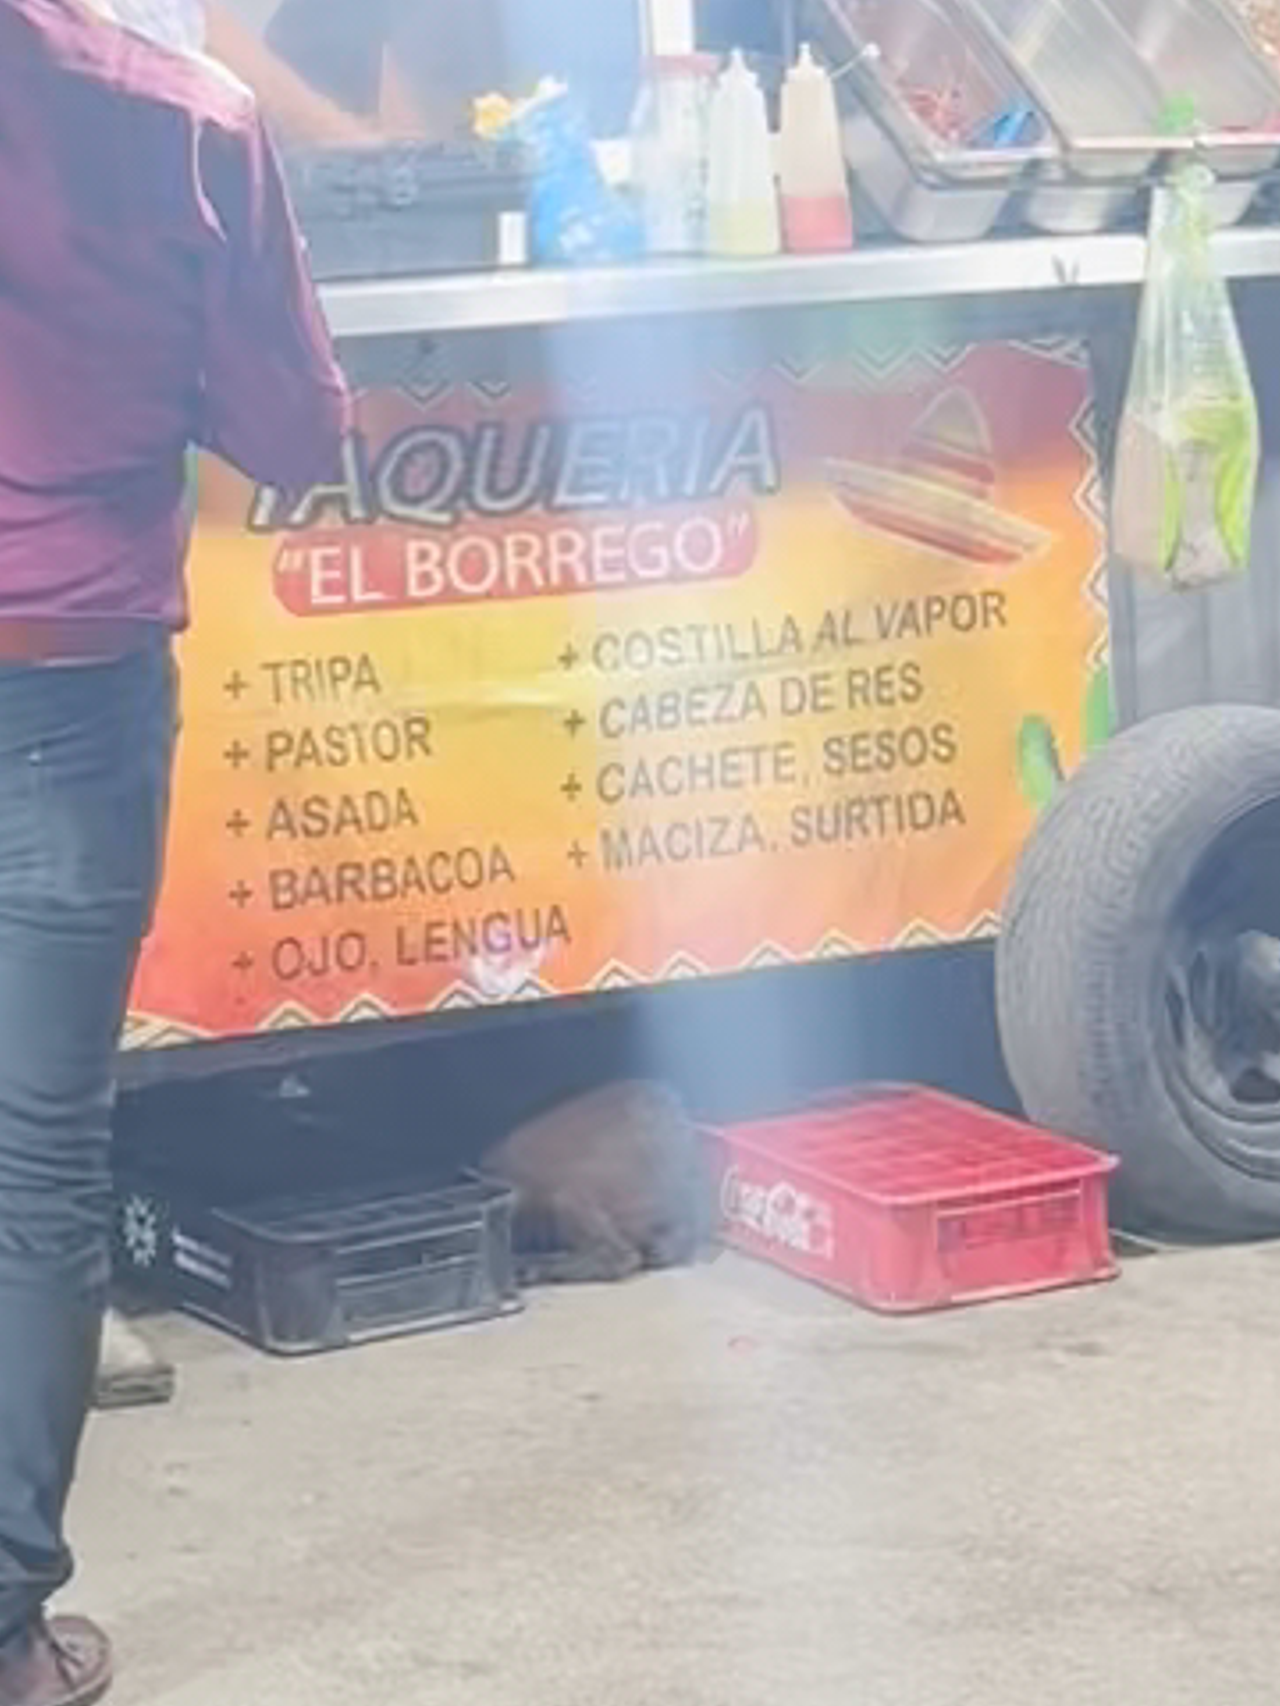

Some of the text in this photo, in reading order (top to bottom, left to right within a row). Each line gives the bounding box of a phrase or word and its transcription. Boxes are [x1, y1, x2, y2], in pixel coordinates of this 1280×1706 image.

[592, 614, 803, 672] COSTILLA
[810, 607, 870, 652] AL
[874, 590, 1008, 642] VAPOR
[261, 652, 382, 704] TRIPA
[599, 680, 767, 739] CABEZA
[780, 672, 836, 717] DE
[846, 660, 926, 710] RES
[265, 716, 433, 773] PASTOR
[823, 722, 959, 777] SESOS
[266, 787, 420, 840] ASADA
[790, 789, 967, 848] SURTIDA
[269, 844, 517, 911] BARBACOA
[396, 904, 572, 966] LENGUA
